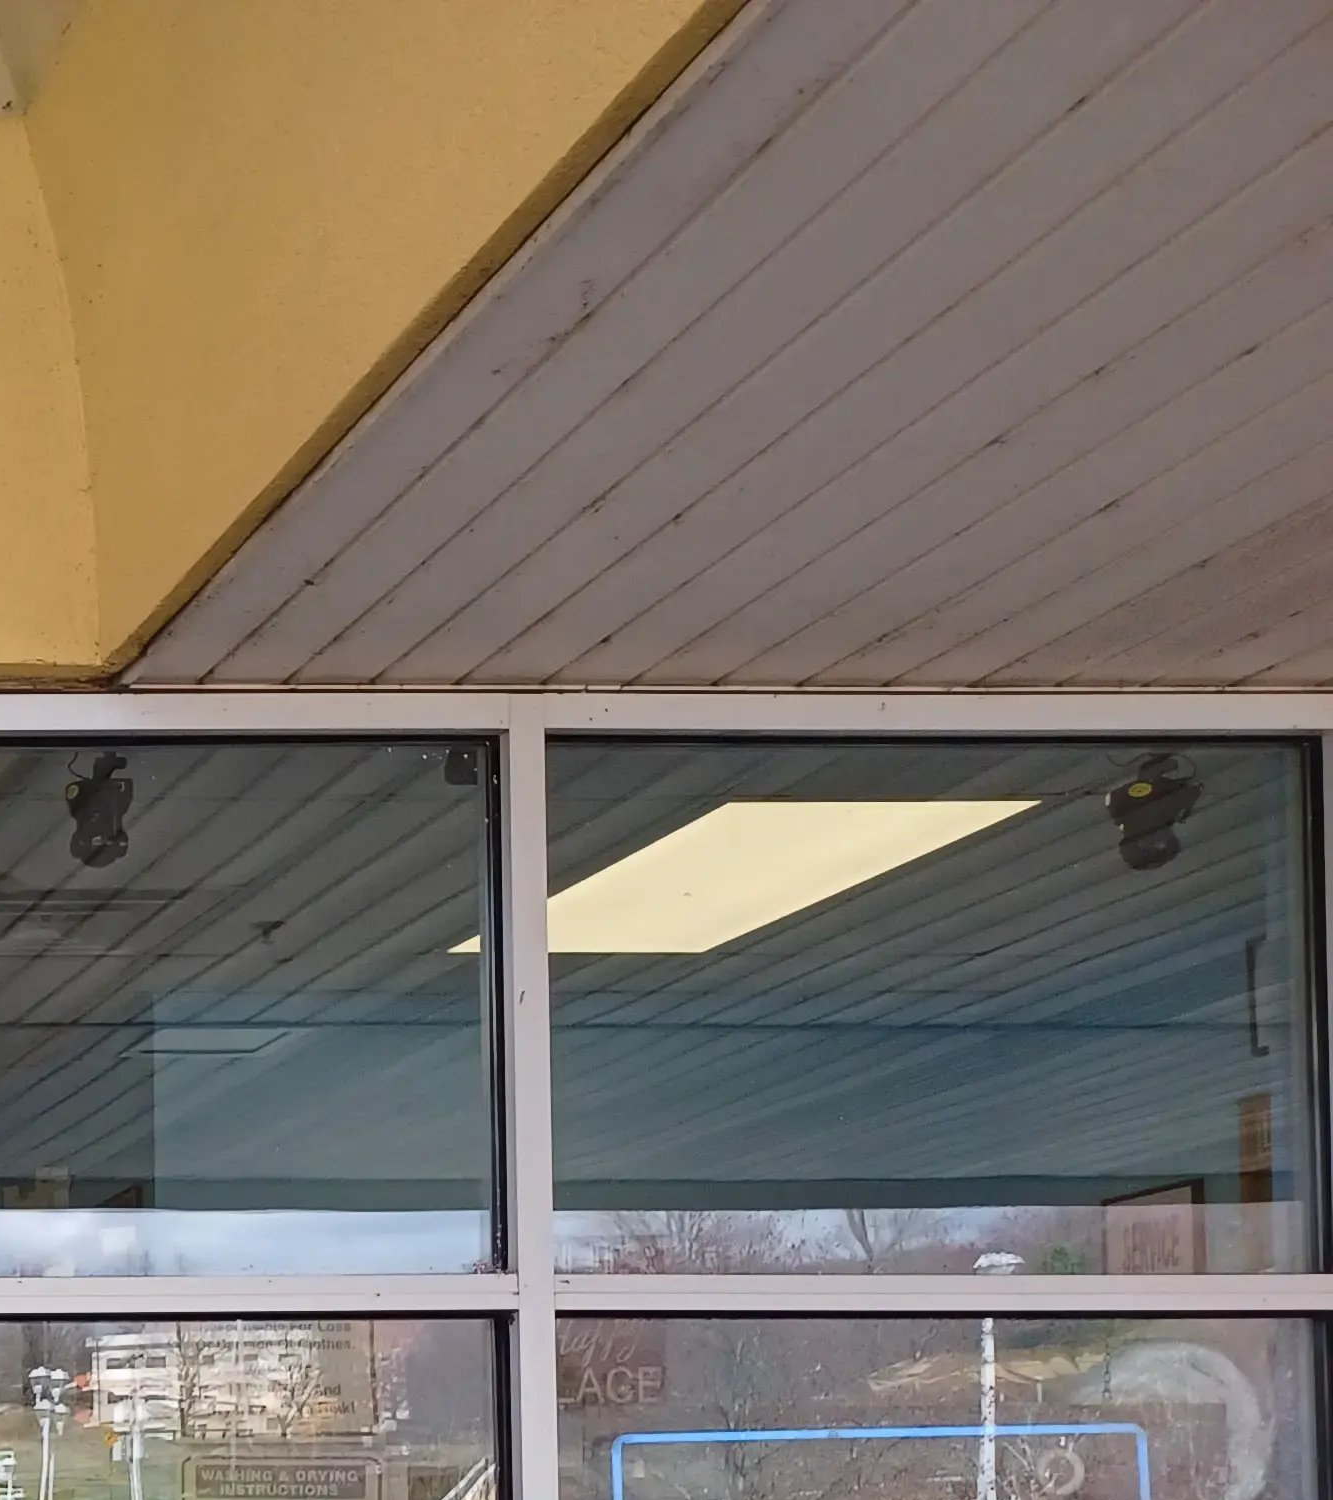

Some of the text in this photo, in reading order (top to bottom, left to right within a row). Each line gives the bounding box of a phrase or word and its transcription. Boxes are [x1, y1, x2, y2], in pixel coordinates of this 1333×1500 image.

[559, 1366, 664, 1404] ACE
[201, 1470, 359, 1483] WASHING & DRYING
[220, 1483, 339, 1496] INSTRUCTIONS
